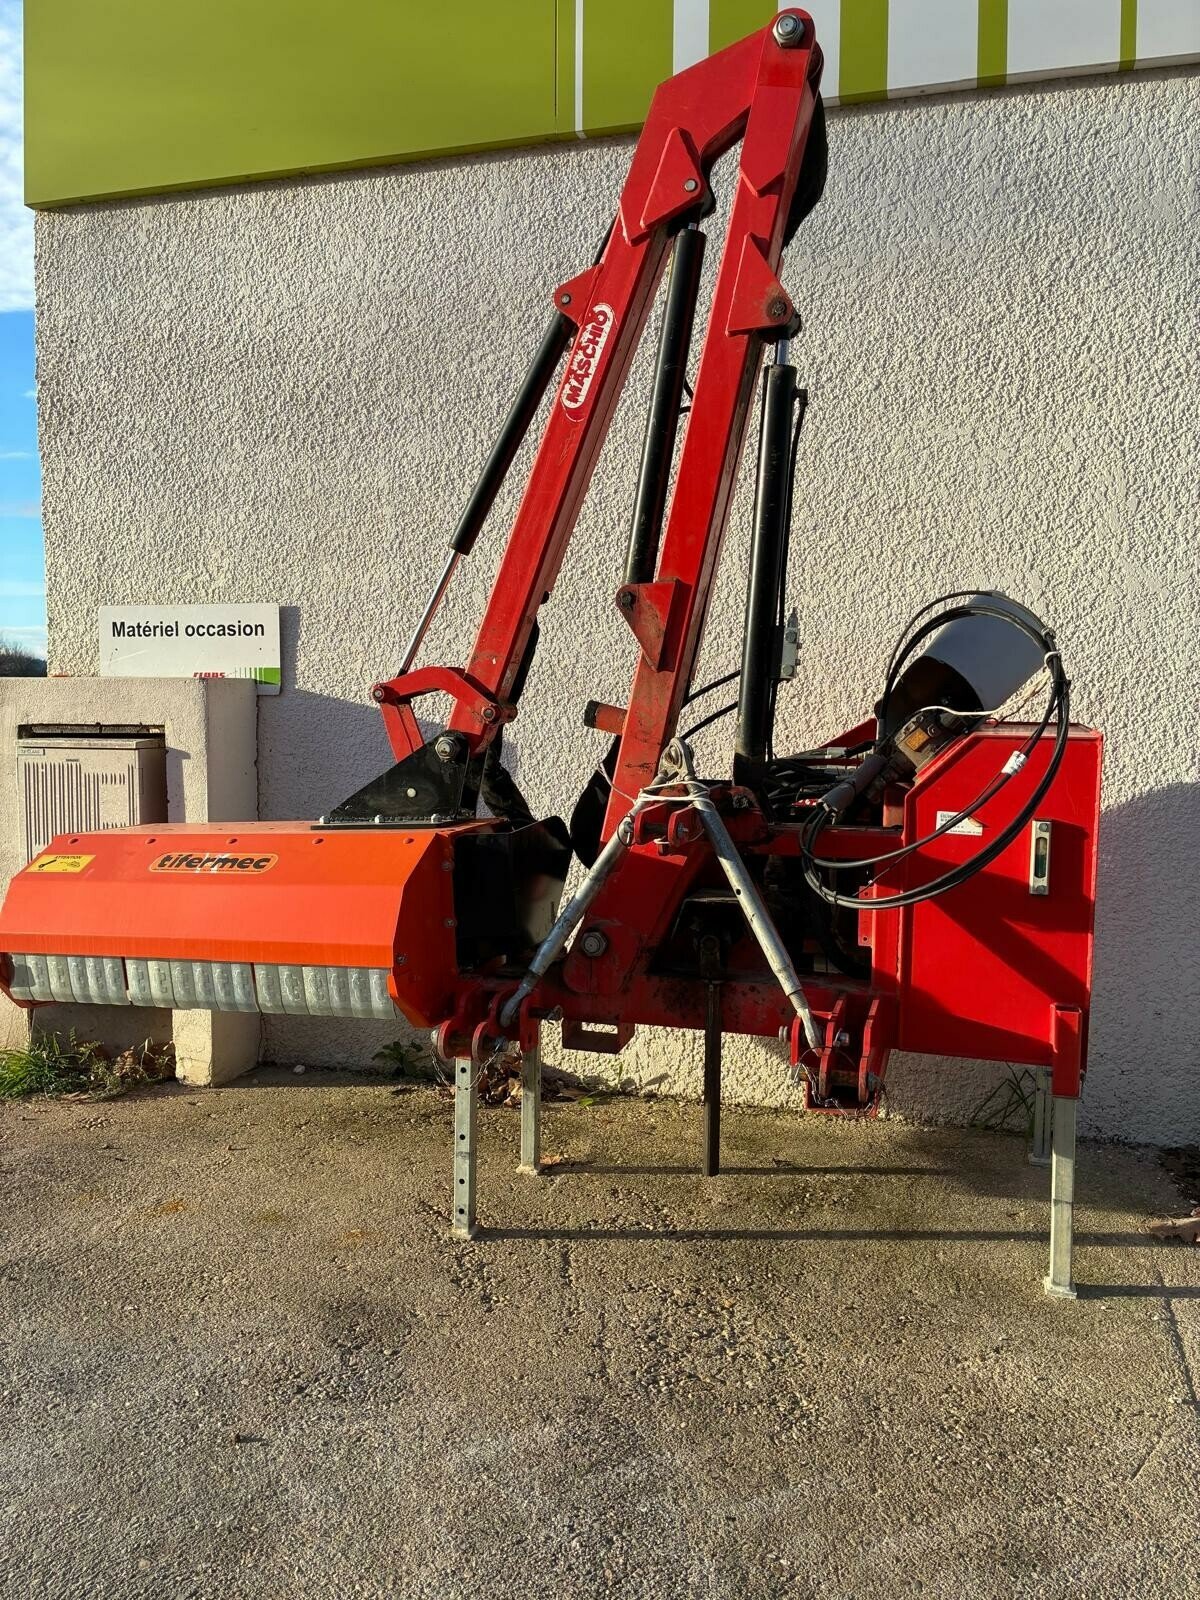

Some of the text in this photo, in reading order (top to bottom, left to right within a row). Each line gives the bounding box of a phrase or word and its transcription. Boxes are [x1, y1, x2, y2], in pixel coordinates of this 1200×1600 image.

[566, 310, 608, 404] MASCHIO
[112, 620, 265, 637] Matériel occasion
[157, 854, 271, 869] tifermec
